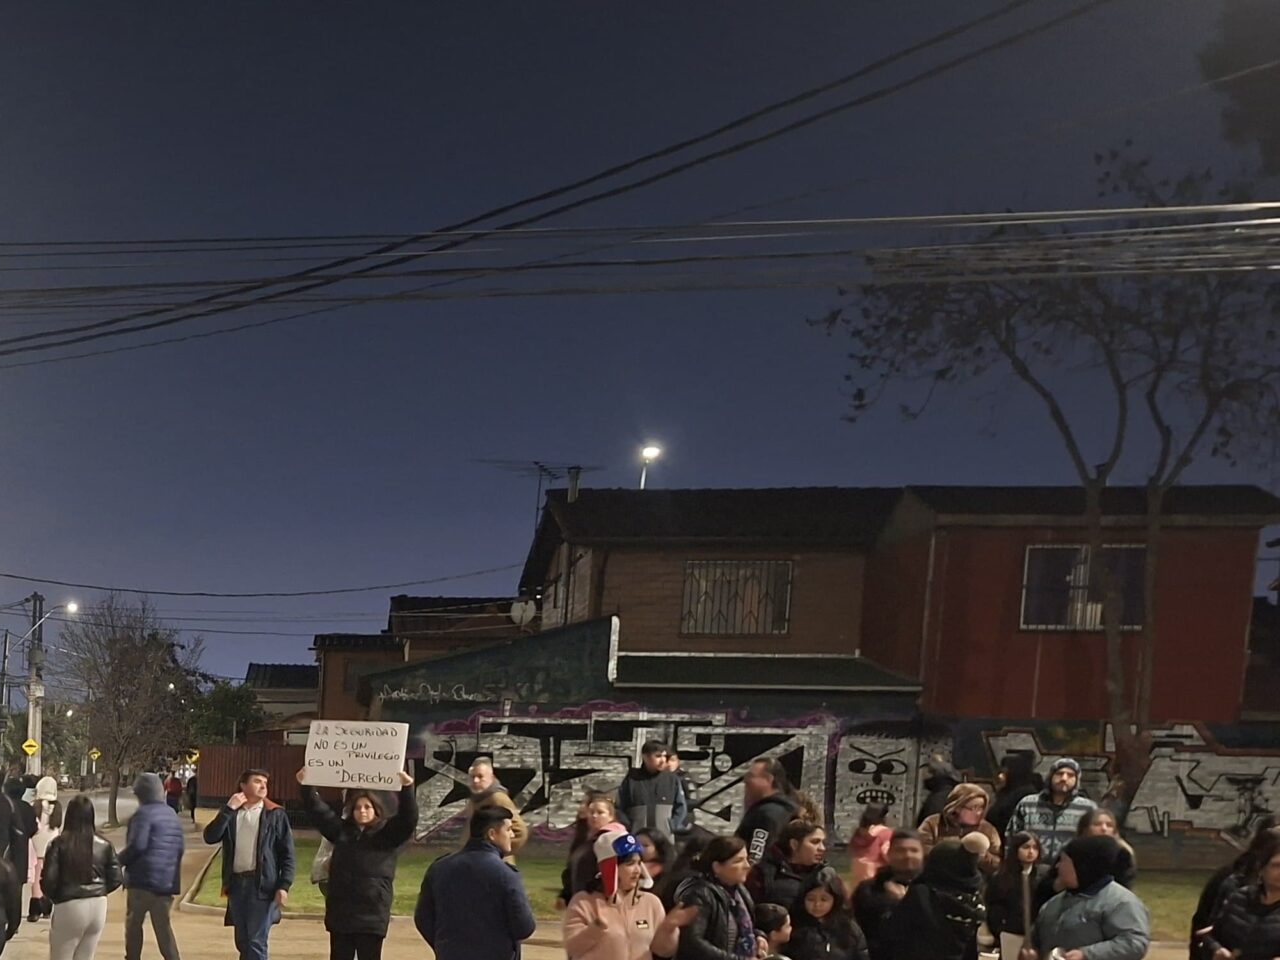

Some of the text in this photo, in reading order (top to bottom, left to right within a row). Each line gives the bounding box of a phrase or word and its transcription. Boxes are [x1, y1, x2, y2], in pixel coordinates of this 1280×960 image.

[314, 739, 367, 750] NO ES UN
[308, 759, 344, 767] ES UN
